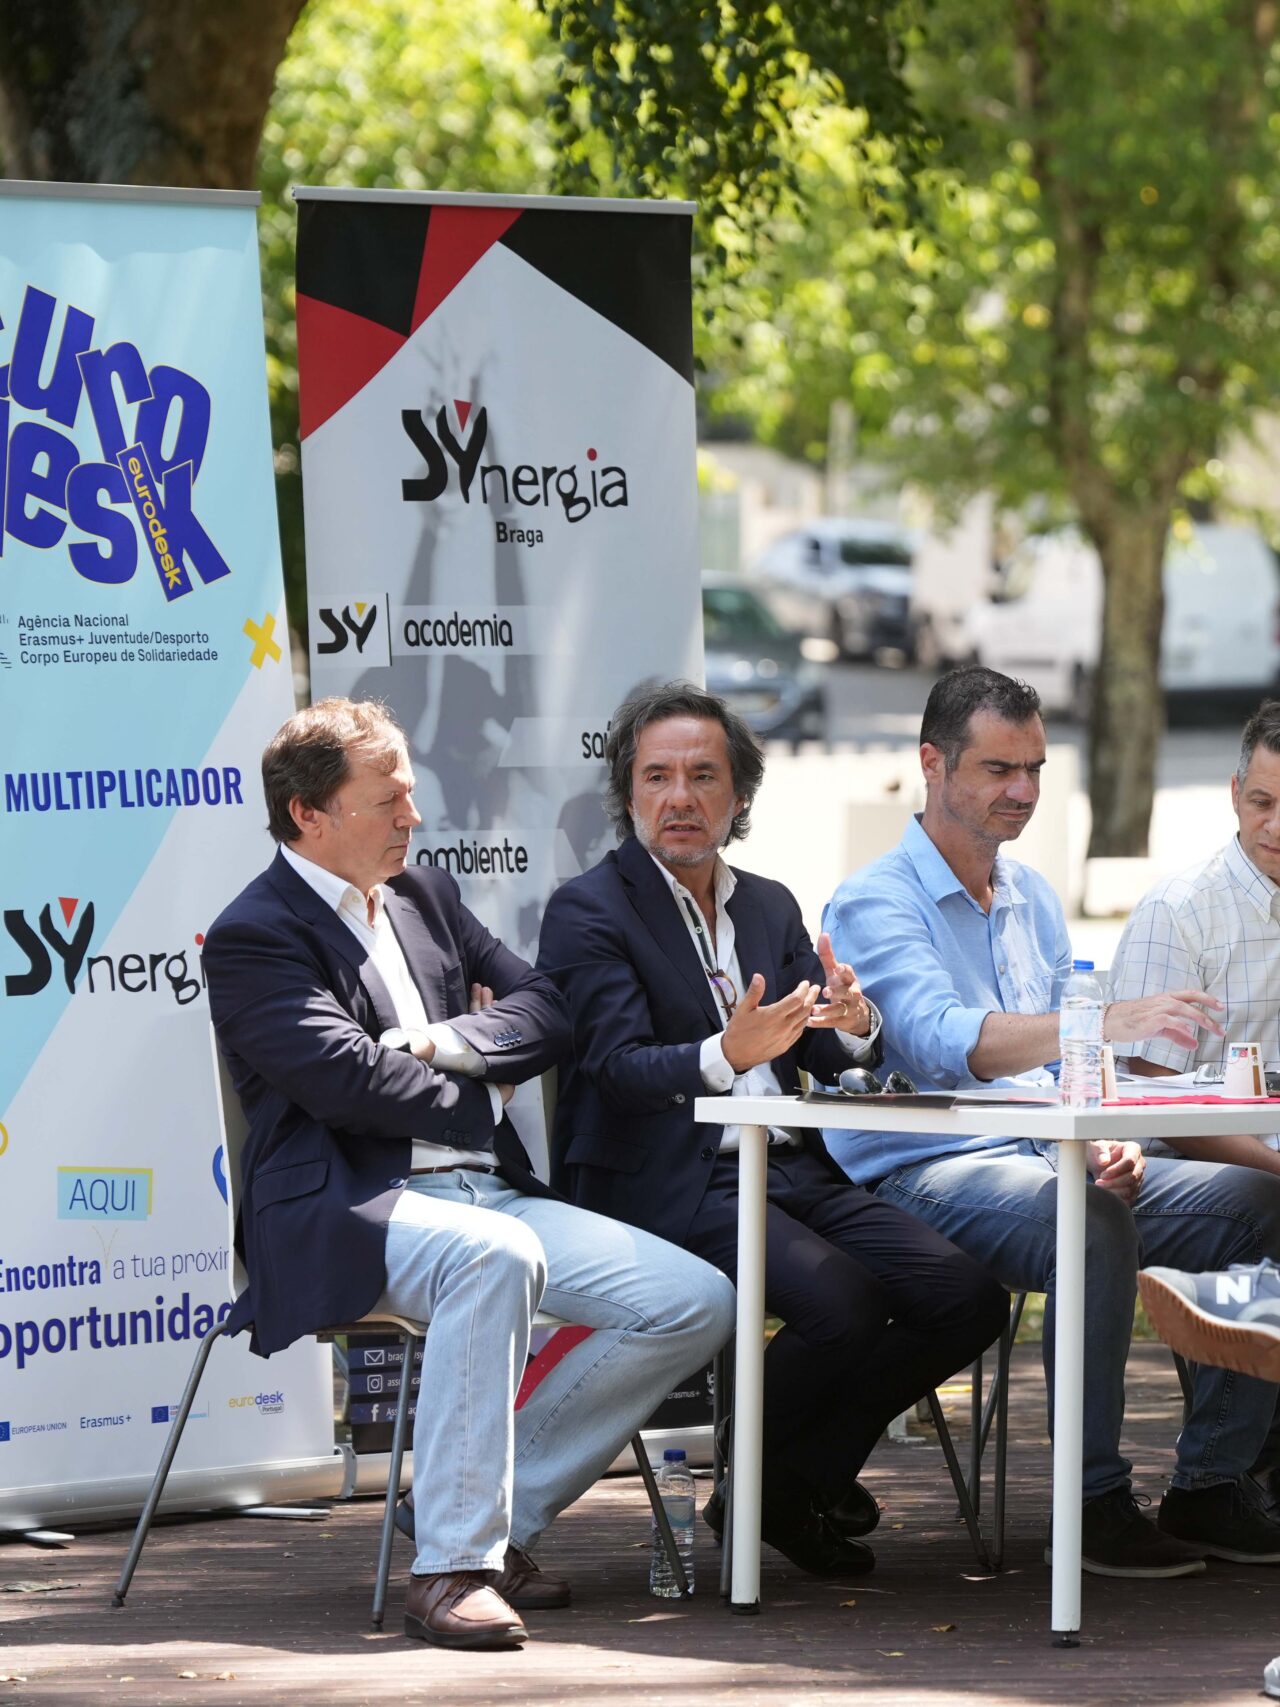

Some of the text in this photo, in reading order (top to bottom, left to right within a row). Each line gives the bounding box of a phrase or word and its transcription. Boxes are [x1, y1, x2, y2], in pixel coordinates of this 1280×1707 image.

[0, 284, 210, 488] uro
[401, 399, 628, 523] SYnergia
[0, 400, 231, 602] esk
[127, 456, 182, 590] eurodesk
[495, 521, 544, 547] Braga
[18, 615, 71, 631] Agência
[74, 613, 129, 627] Nacional
[19, 631, 209, 647] Erasmus+ Juventude/Desporto
[403, 611, 513, 647] academia
[20, 648, 218, 666] Corpo Europeu de Solidariedade
[4, 767, 243, 812] MULTIPLICADOR
[416, 838, 528, 874] ambiente
[3, 897, 208, 1005] SYnergi
[69, 1178, 136, 1214] AQUI
[113, 1259, 125, 1280] a
[130, 1254, 166, 1278] tua
[1215, 1275, 1251, 1305] N
[228, 1391, 284, 1408] eurodesk
[11, 1421, 67, 1435] EUROPEAN UNION
